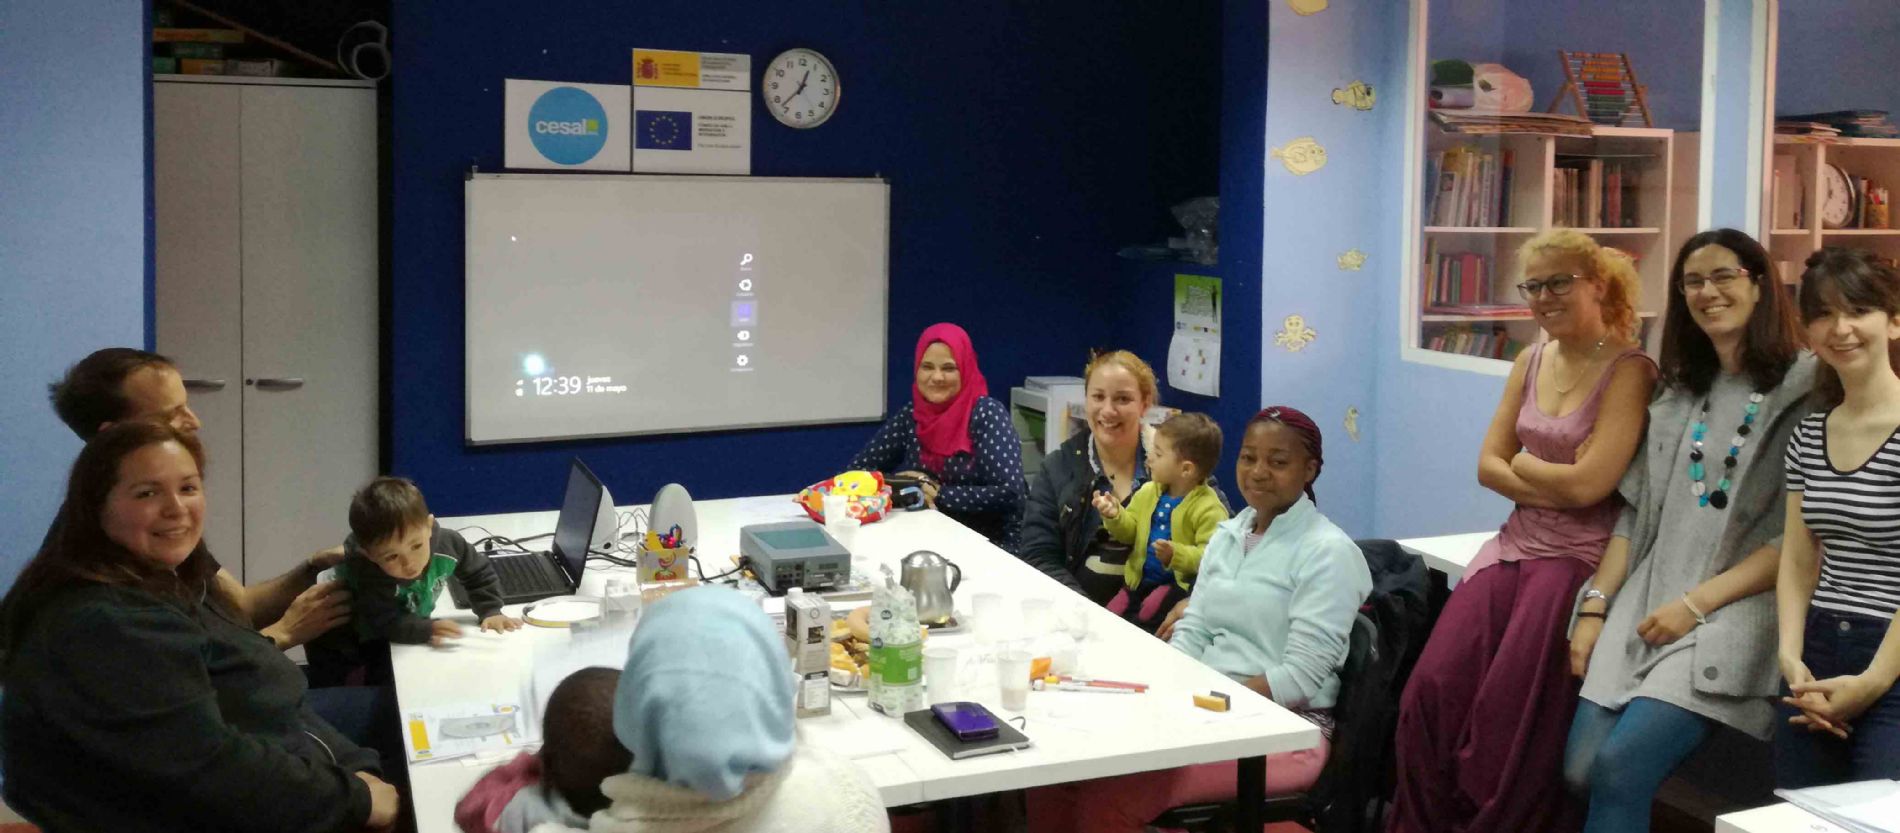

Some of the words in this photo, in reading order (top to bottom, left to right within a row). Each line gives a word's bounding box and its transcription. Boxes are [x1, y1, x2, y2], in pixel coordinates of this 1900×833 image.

[786, 60, 794, 68] 11
[798, 58, 808, 66] 12
[776, 69, 785, 77] 10
[537, 118, 586, 135] cesal
[532, 376, 582, 396] 12:39
[595, 385, 605, 393] de
